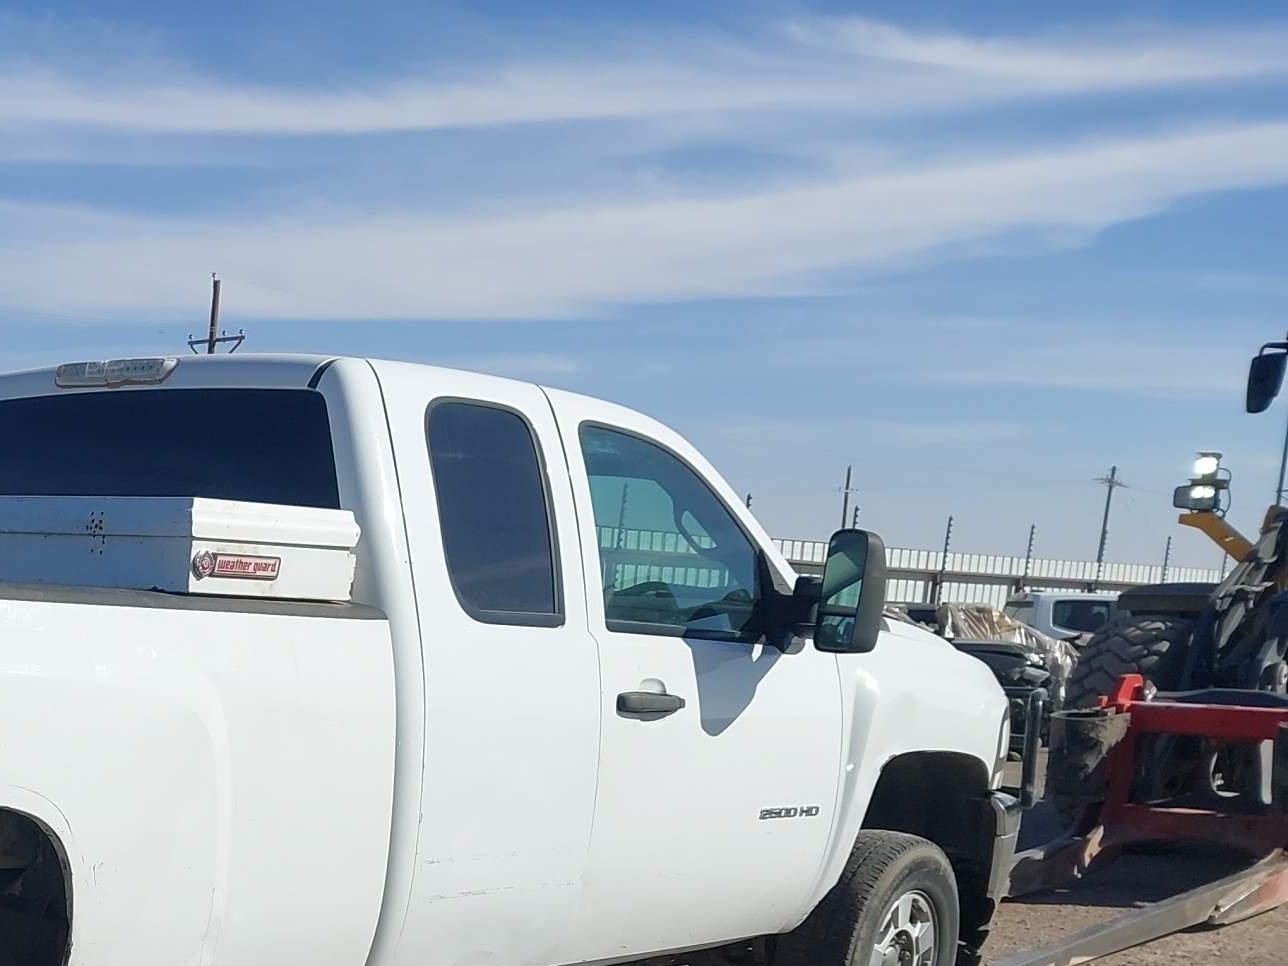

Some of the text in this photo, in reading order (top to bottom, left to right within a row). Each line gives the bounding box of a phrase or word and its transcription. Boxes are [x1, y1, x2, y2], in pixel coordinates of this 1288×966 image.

[217, 558, 277, 573] weather guard
[759, 806, 820, 820] 2500 HD
